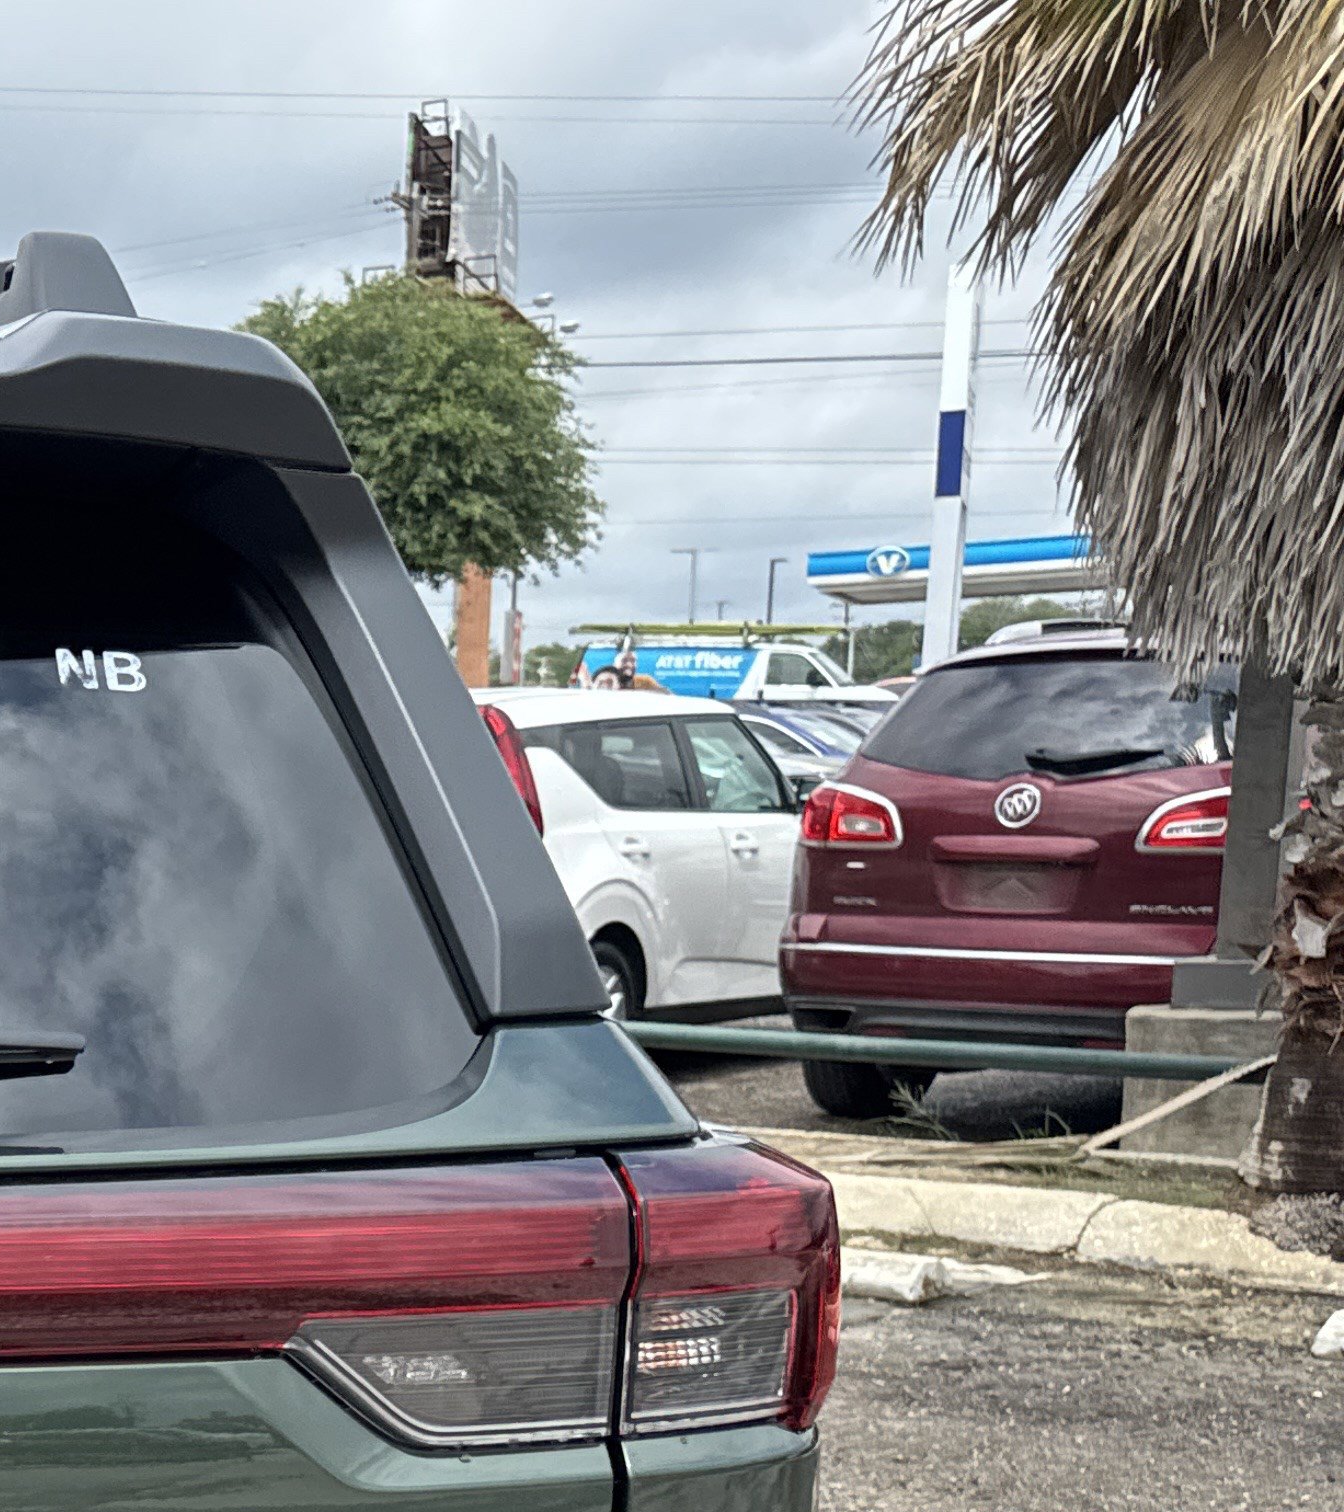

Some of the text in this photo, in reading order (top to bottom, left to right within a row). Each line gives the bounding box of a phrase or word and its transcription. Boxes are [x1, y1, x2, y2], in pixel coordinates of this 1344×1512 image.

[55, 648, 147, 692] NB
[655, 651, 744, 669] AT&T fiber
